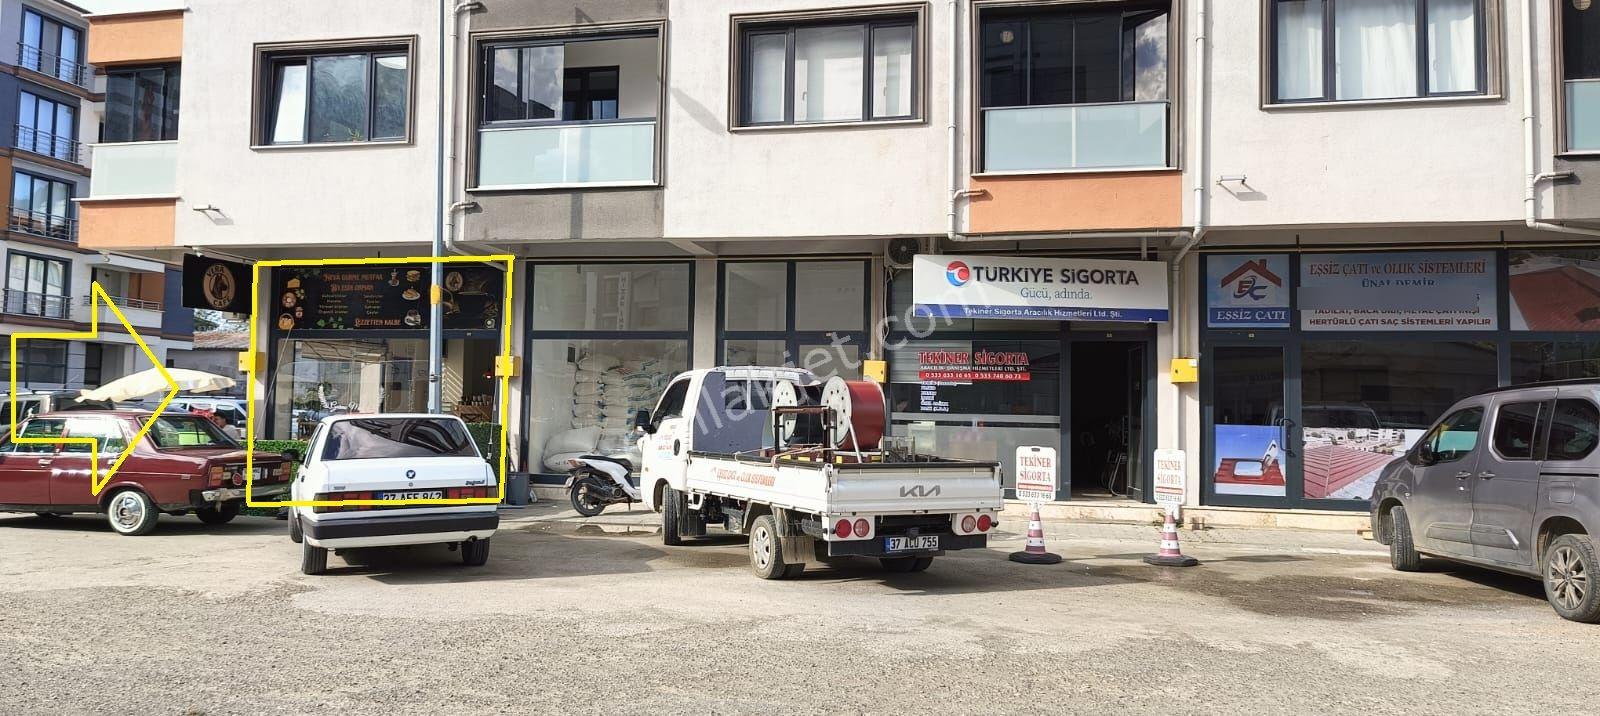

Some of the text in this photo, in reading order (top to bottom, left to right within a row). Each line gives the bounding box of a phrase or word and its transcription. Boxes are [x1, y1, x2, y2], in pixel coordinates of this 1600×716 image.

[1020, 288, 1093, 300] Gücü, adında.
[964, 307, 993, 316] Tekiner
[994, 307, 1022, 317] Sigorta
[918, 348, 1029, 366] TEKİNER SİGORTA
[1019, 455, 1052, 468] TEKİNER
[1019, 468, 1052, 482] SİGORTA
[899, 484, 941, 498] KIA
[890, 538, 901, 549] 37
[922, 536, 937, 548] 755
